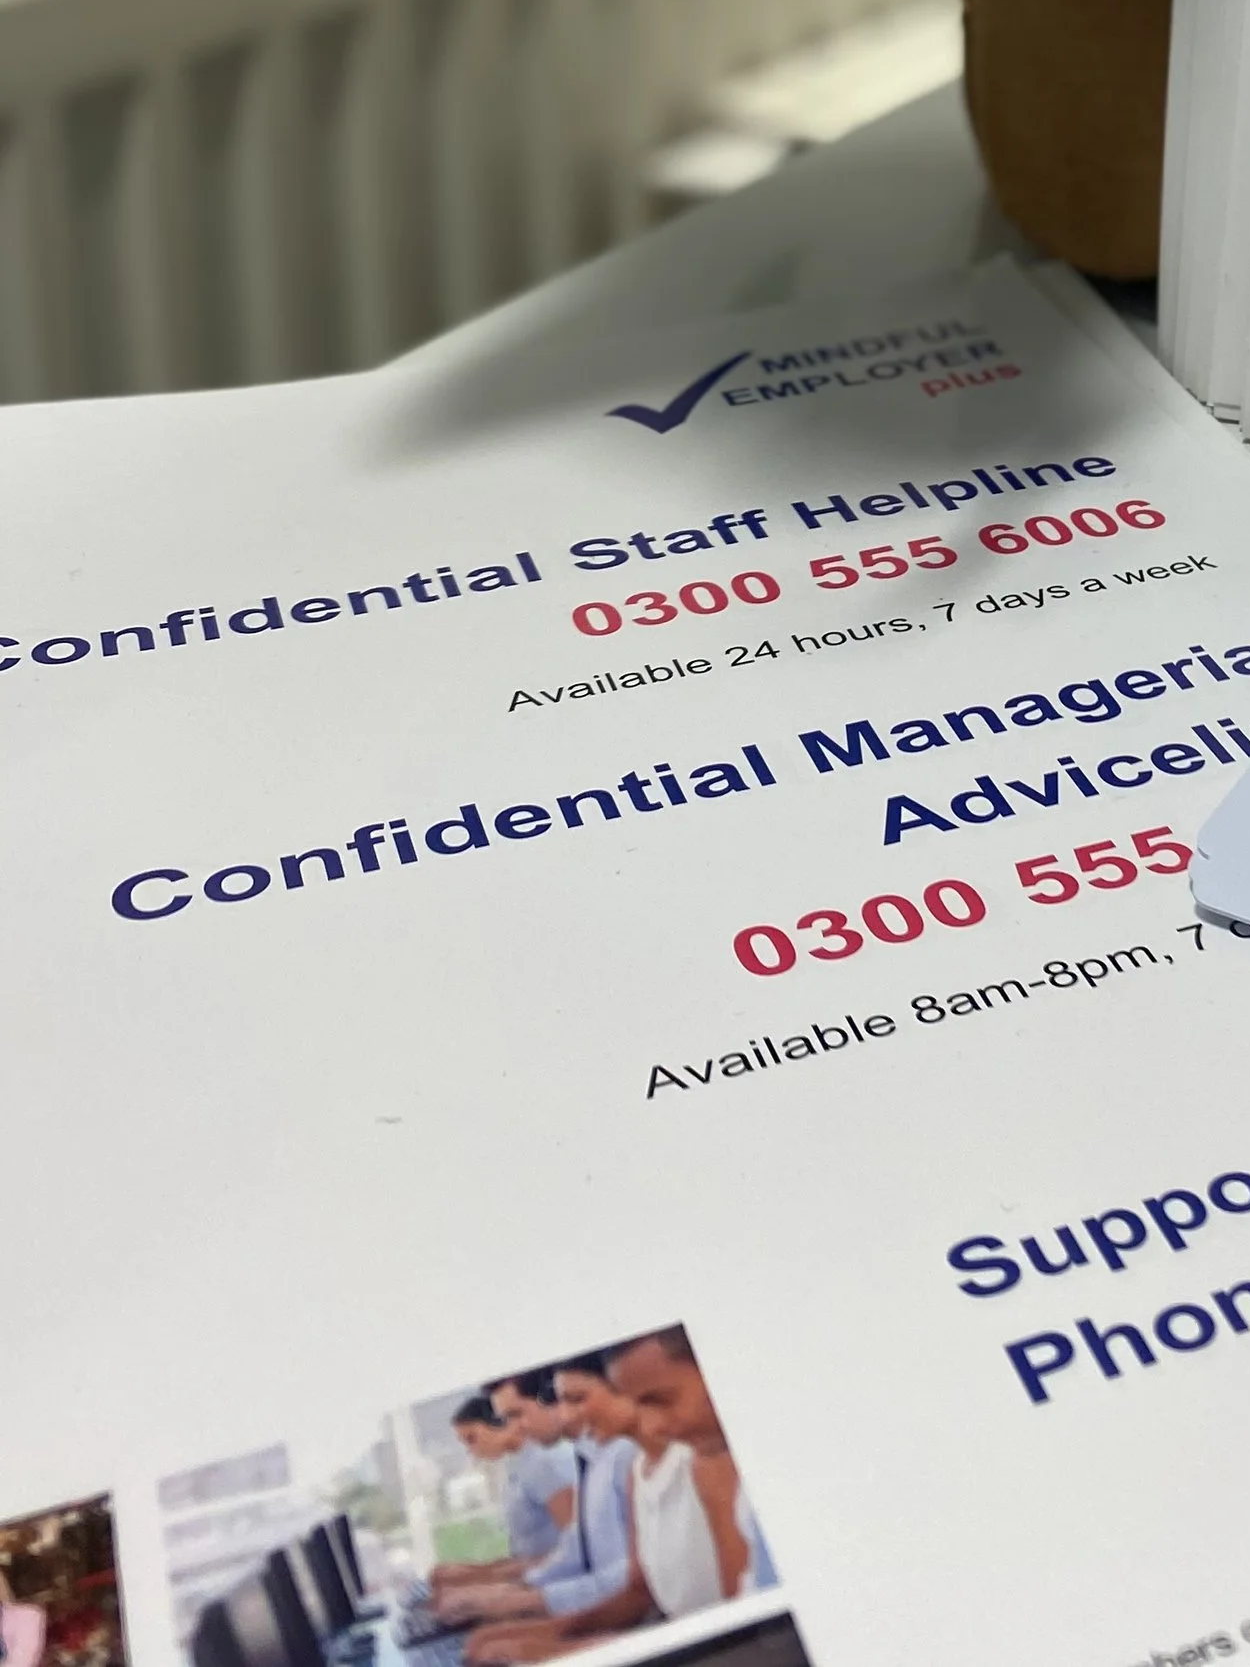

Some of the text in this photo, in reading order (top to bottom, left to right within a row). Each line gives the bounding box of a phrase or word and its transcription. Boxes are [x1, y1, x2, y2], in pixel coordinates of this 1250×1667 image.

[722, 340, 1004, 406] EMPLOYER
[759, 319, 988, 375] MINDFUL
[921, 362, 1022, 398] plus
[569, 509, 768, 571] Staff
[792, 455, 1117, 529] Helpline
[571, 500, 1167, 636] 0300 555 6006
[507, 554, 1218, 712] Available 24 hours, 7 days a week
[111, 746, 777, 921] Confidential
[733, 826, 1193, 976] 0300 555
[645, 924, 1206, 1099] Available 8am-8pm, 7
